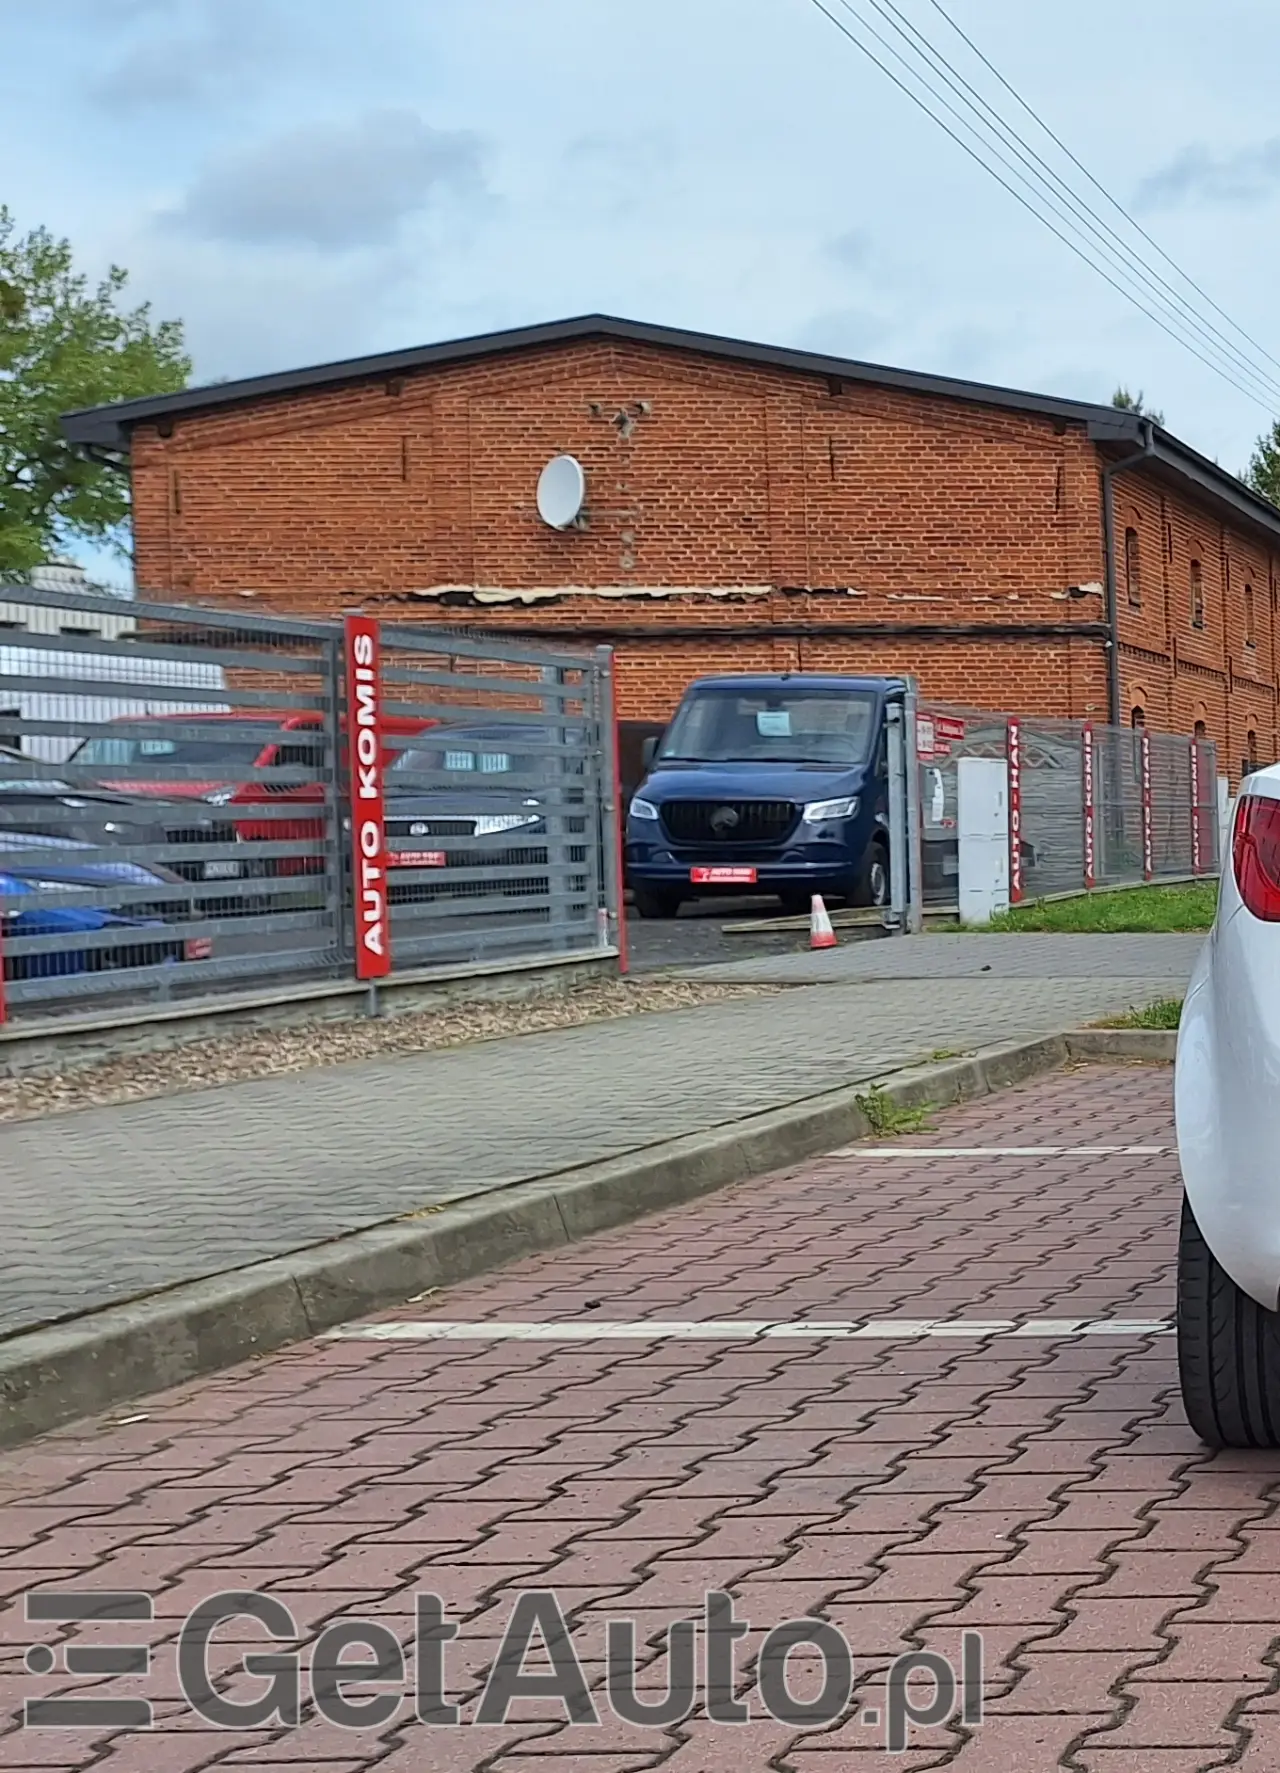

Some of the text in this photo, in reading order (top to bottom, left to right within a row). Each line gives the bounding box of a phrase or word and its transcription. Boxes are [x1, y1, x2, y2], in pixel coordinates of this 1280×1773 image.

[354, 633, 384, 956] AUTO KOMIS
[1084, 730, 1094, 878] AUTO KOMIS
